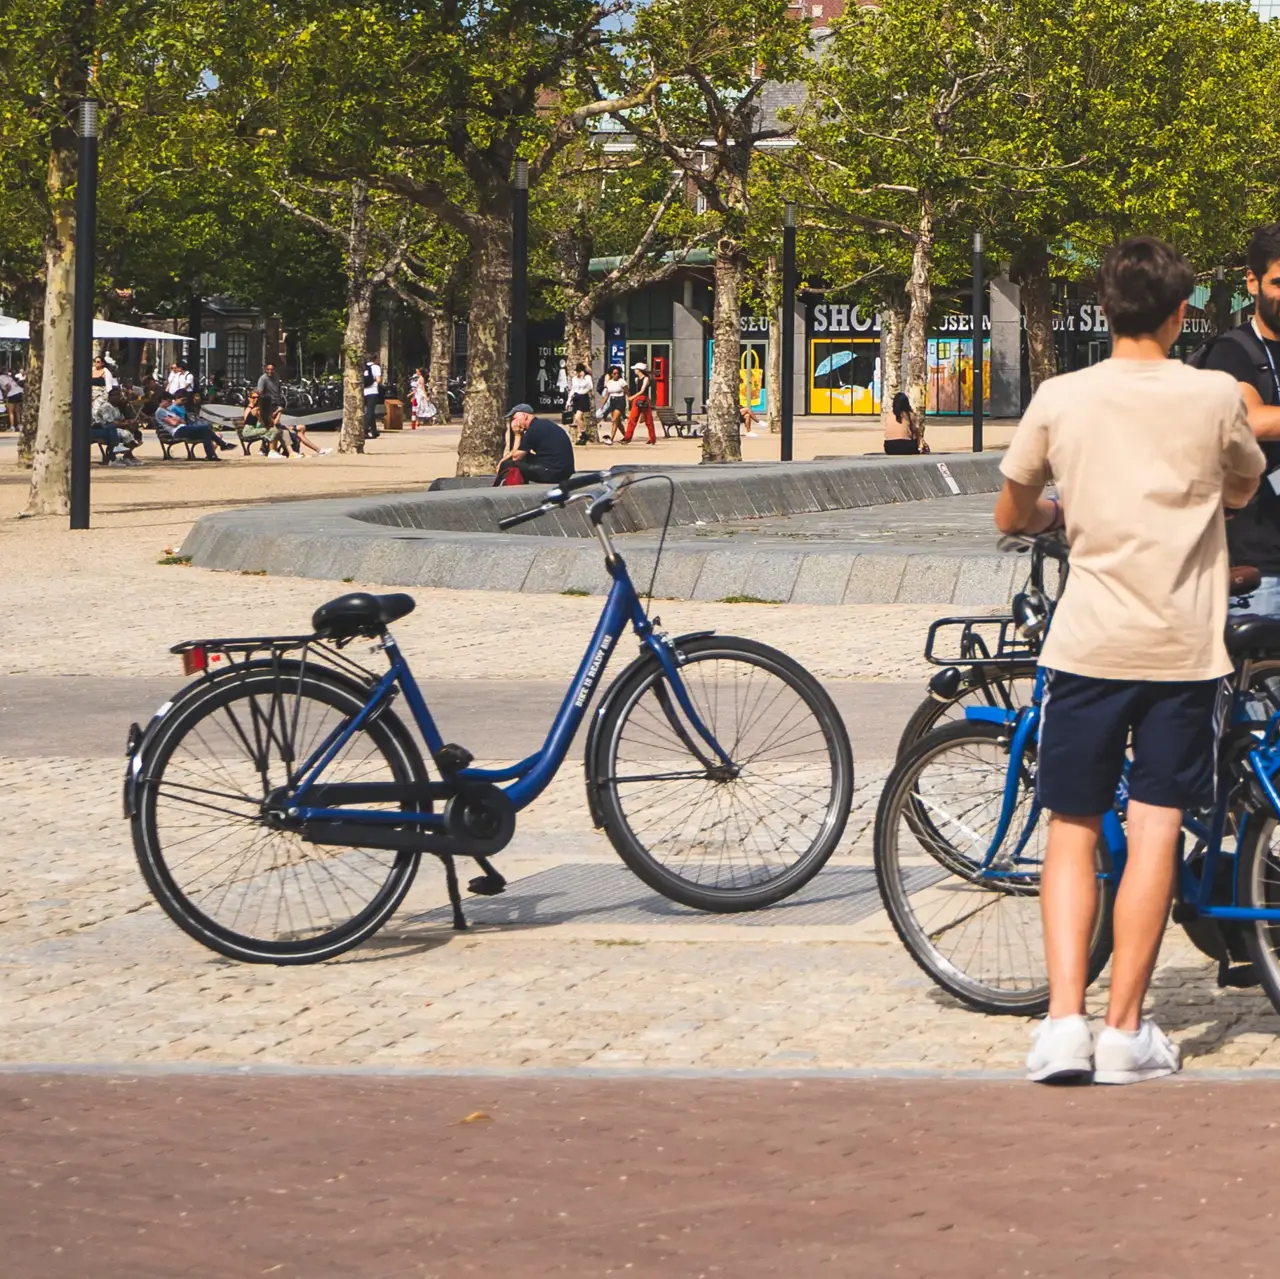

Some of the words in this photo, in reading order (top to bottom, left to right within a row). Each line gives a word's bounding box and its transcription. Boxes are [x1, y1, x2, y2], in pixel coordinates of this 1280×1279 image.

[588, 649, 605, 678] READY
[584, 677, 593, 687] IS
[575, 687, 590, 707] BIKE
